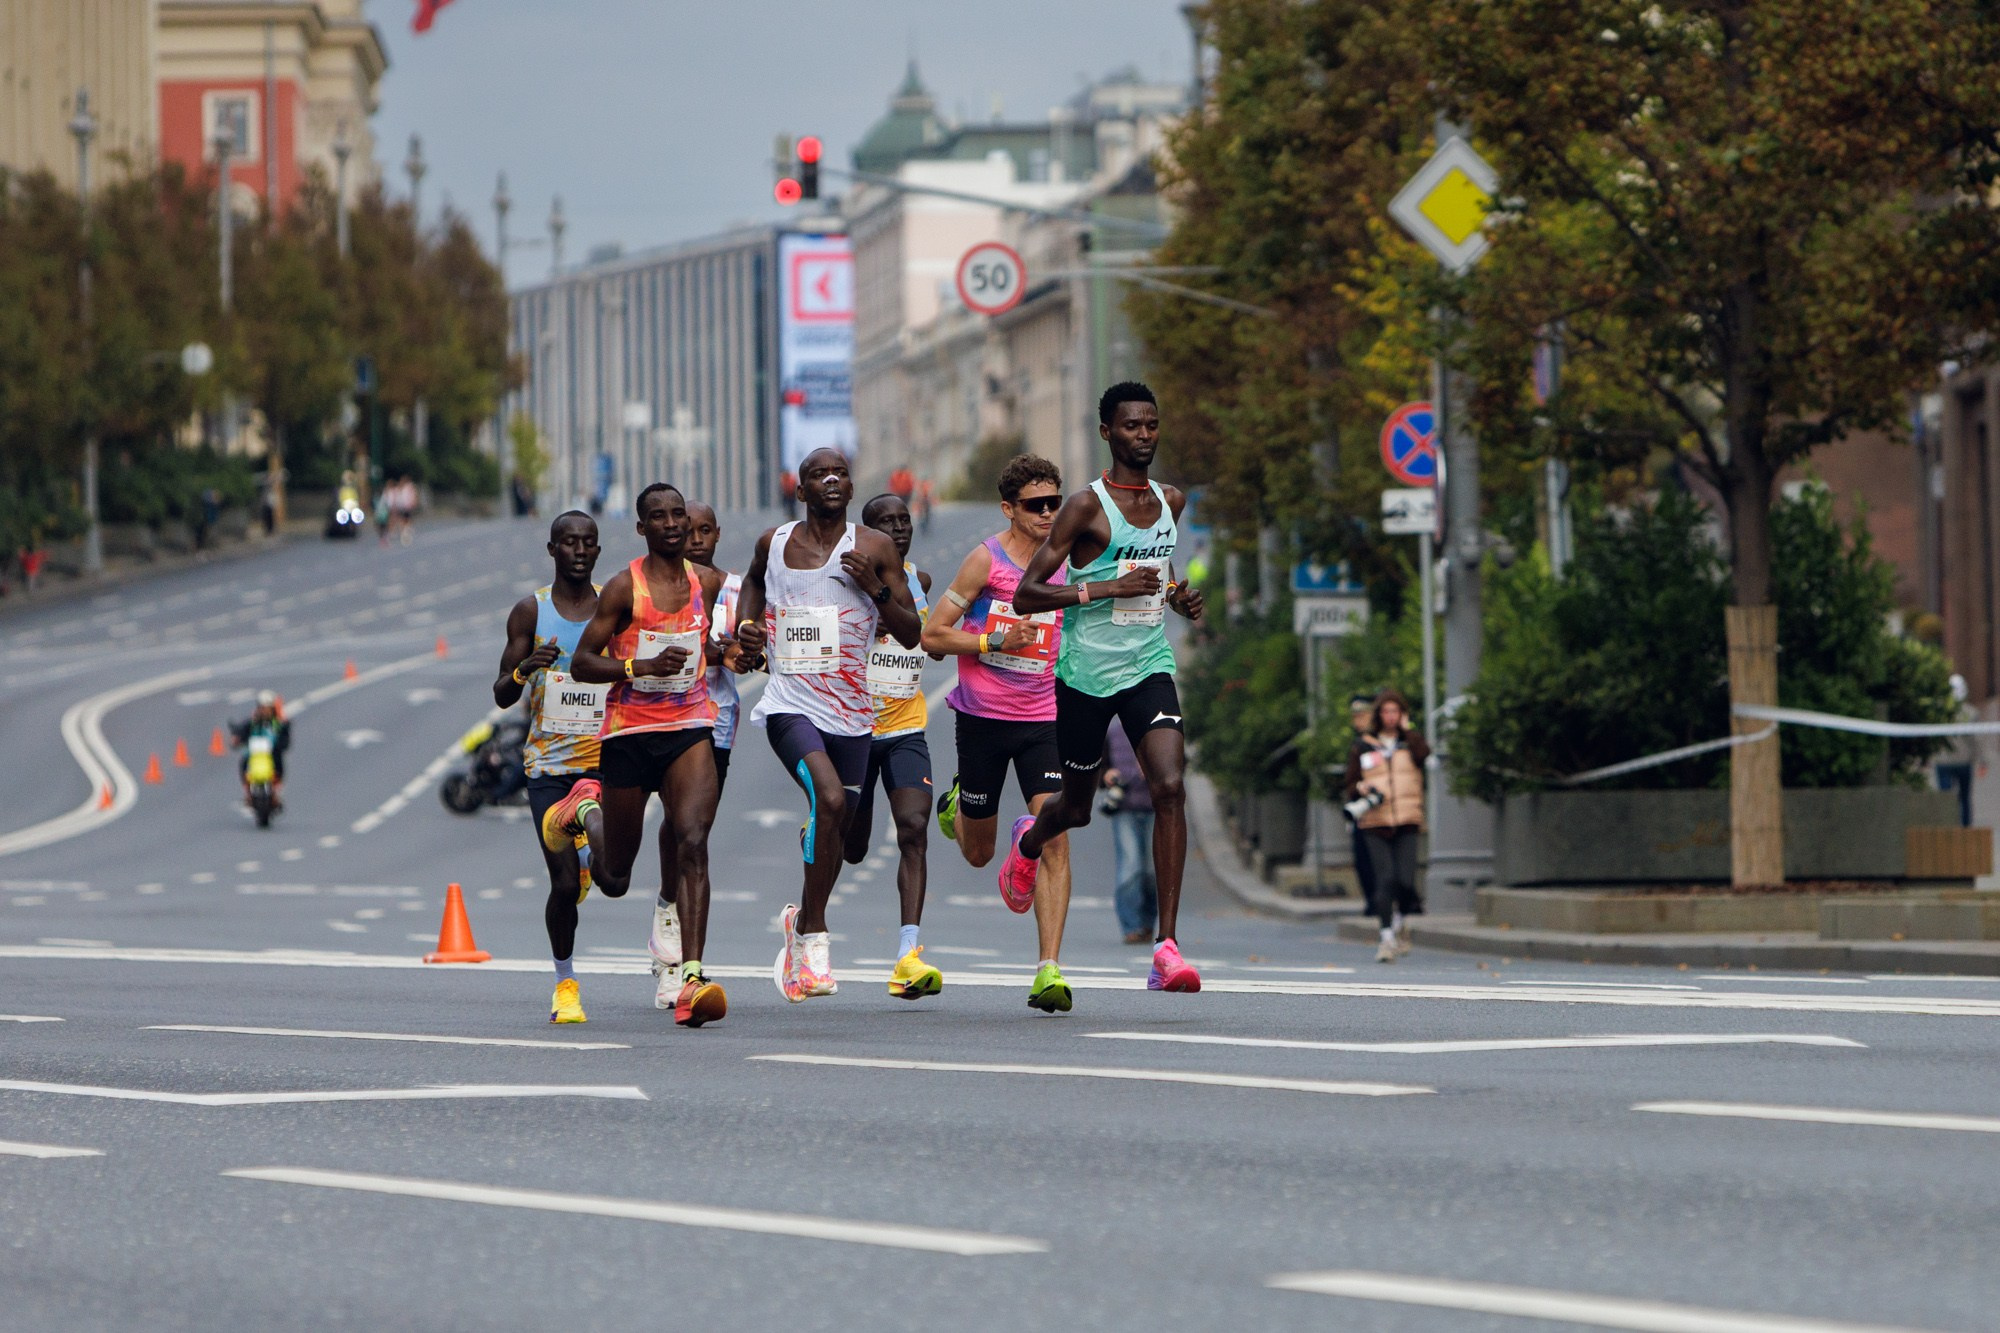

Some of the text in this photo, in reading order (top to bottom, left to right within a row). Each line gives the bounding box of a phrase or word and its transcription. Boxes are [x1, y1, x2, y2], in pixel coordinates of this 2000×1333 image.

[972, 264, 1009, 292] 50
[786, 627, 820, 642] CHEBII
[871, 653, 925, 670] CHEMWENO
[561, 692, 596, 706] KIMELI
